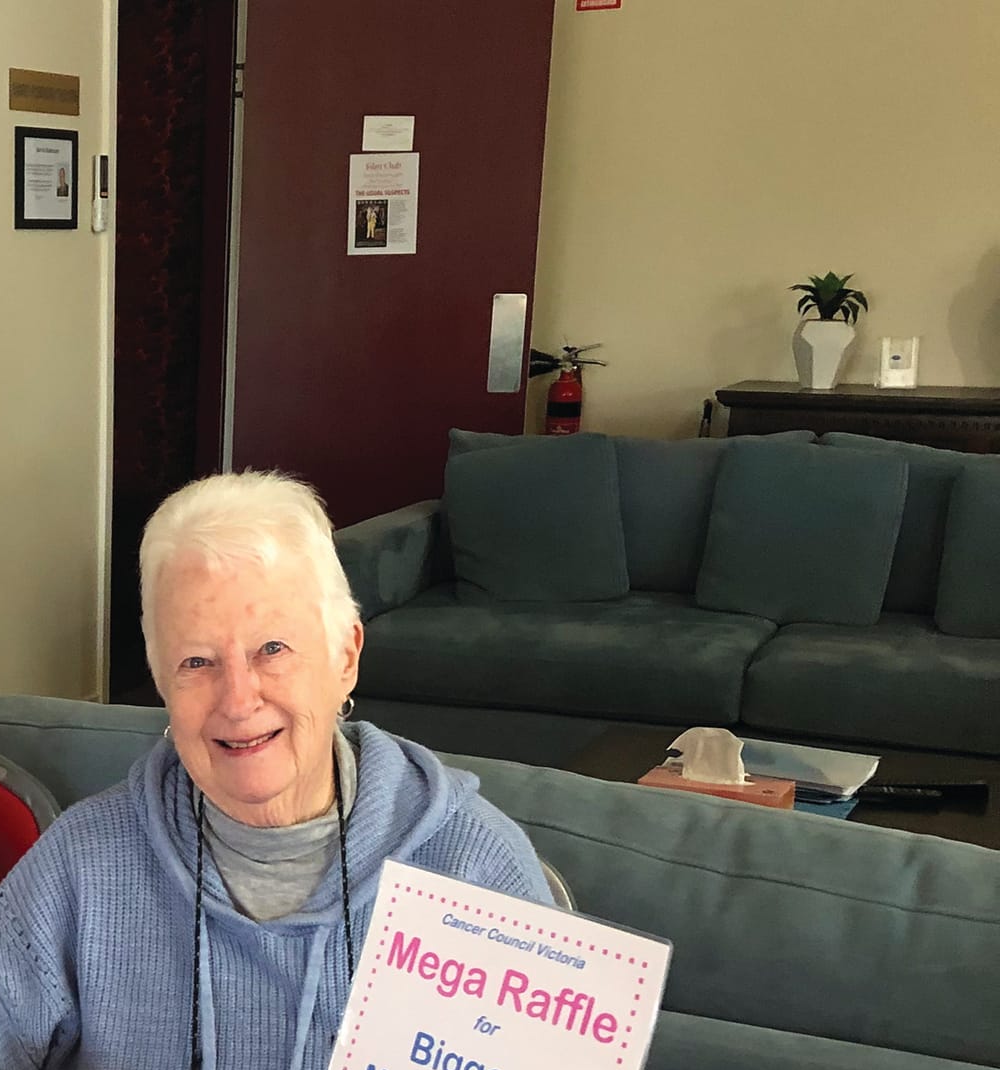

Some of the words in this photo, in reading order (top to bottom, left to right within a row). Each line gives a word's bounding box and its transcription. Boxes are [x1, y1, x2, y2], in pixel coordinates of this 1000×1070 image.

[442, 913, 487, 936] Cancer
[487, 928, 536, 952] Council
[536, 943, 586, 970] Victoria
[386, 930, 488, 999] Mega
[496, 968, 619, 1044] Raffle
[473, 1015, 501, 1036] for
